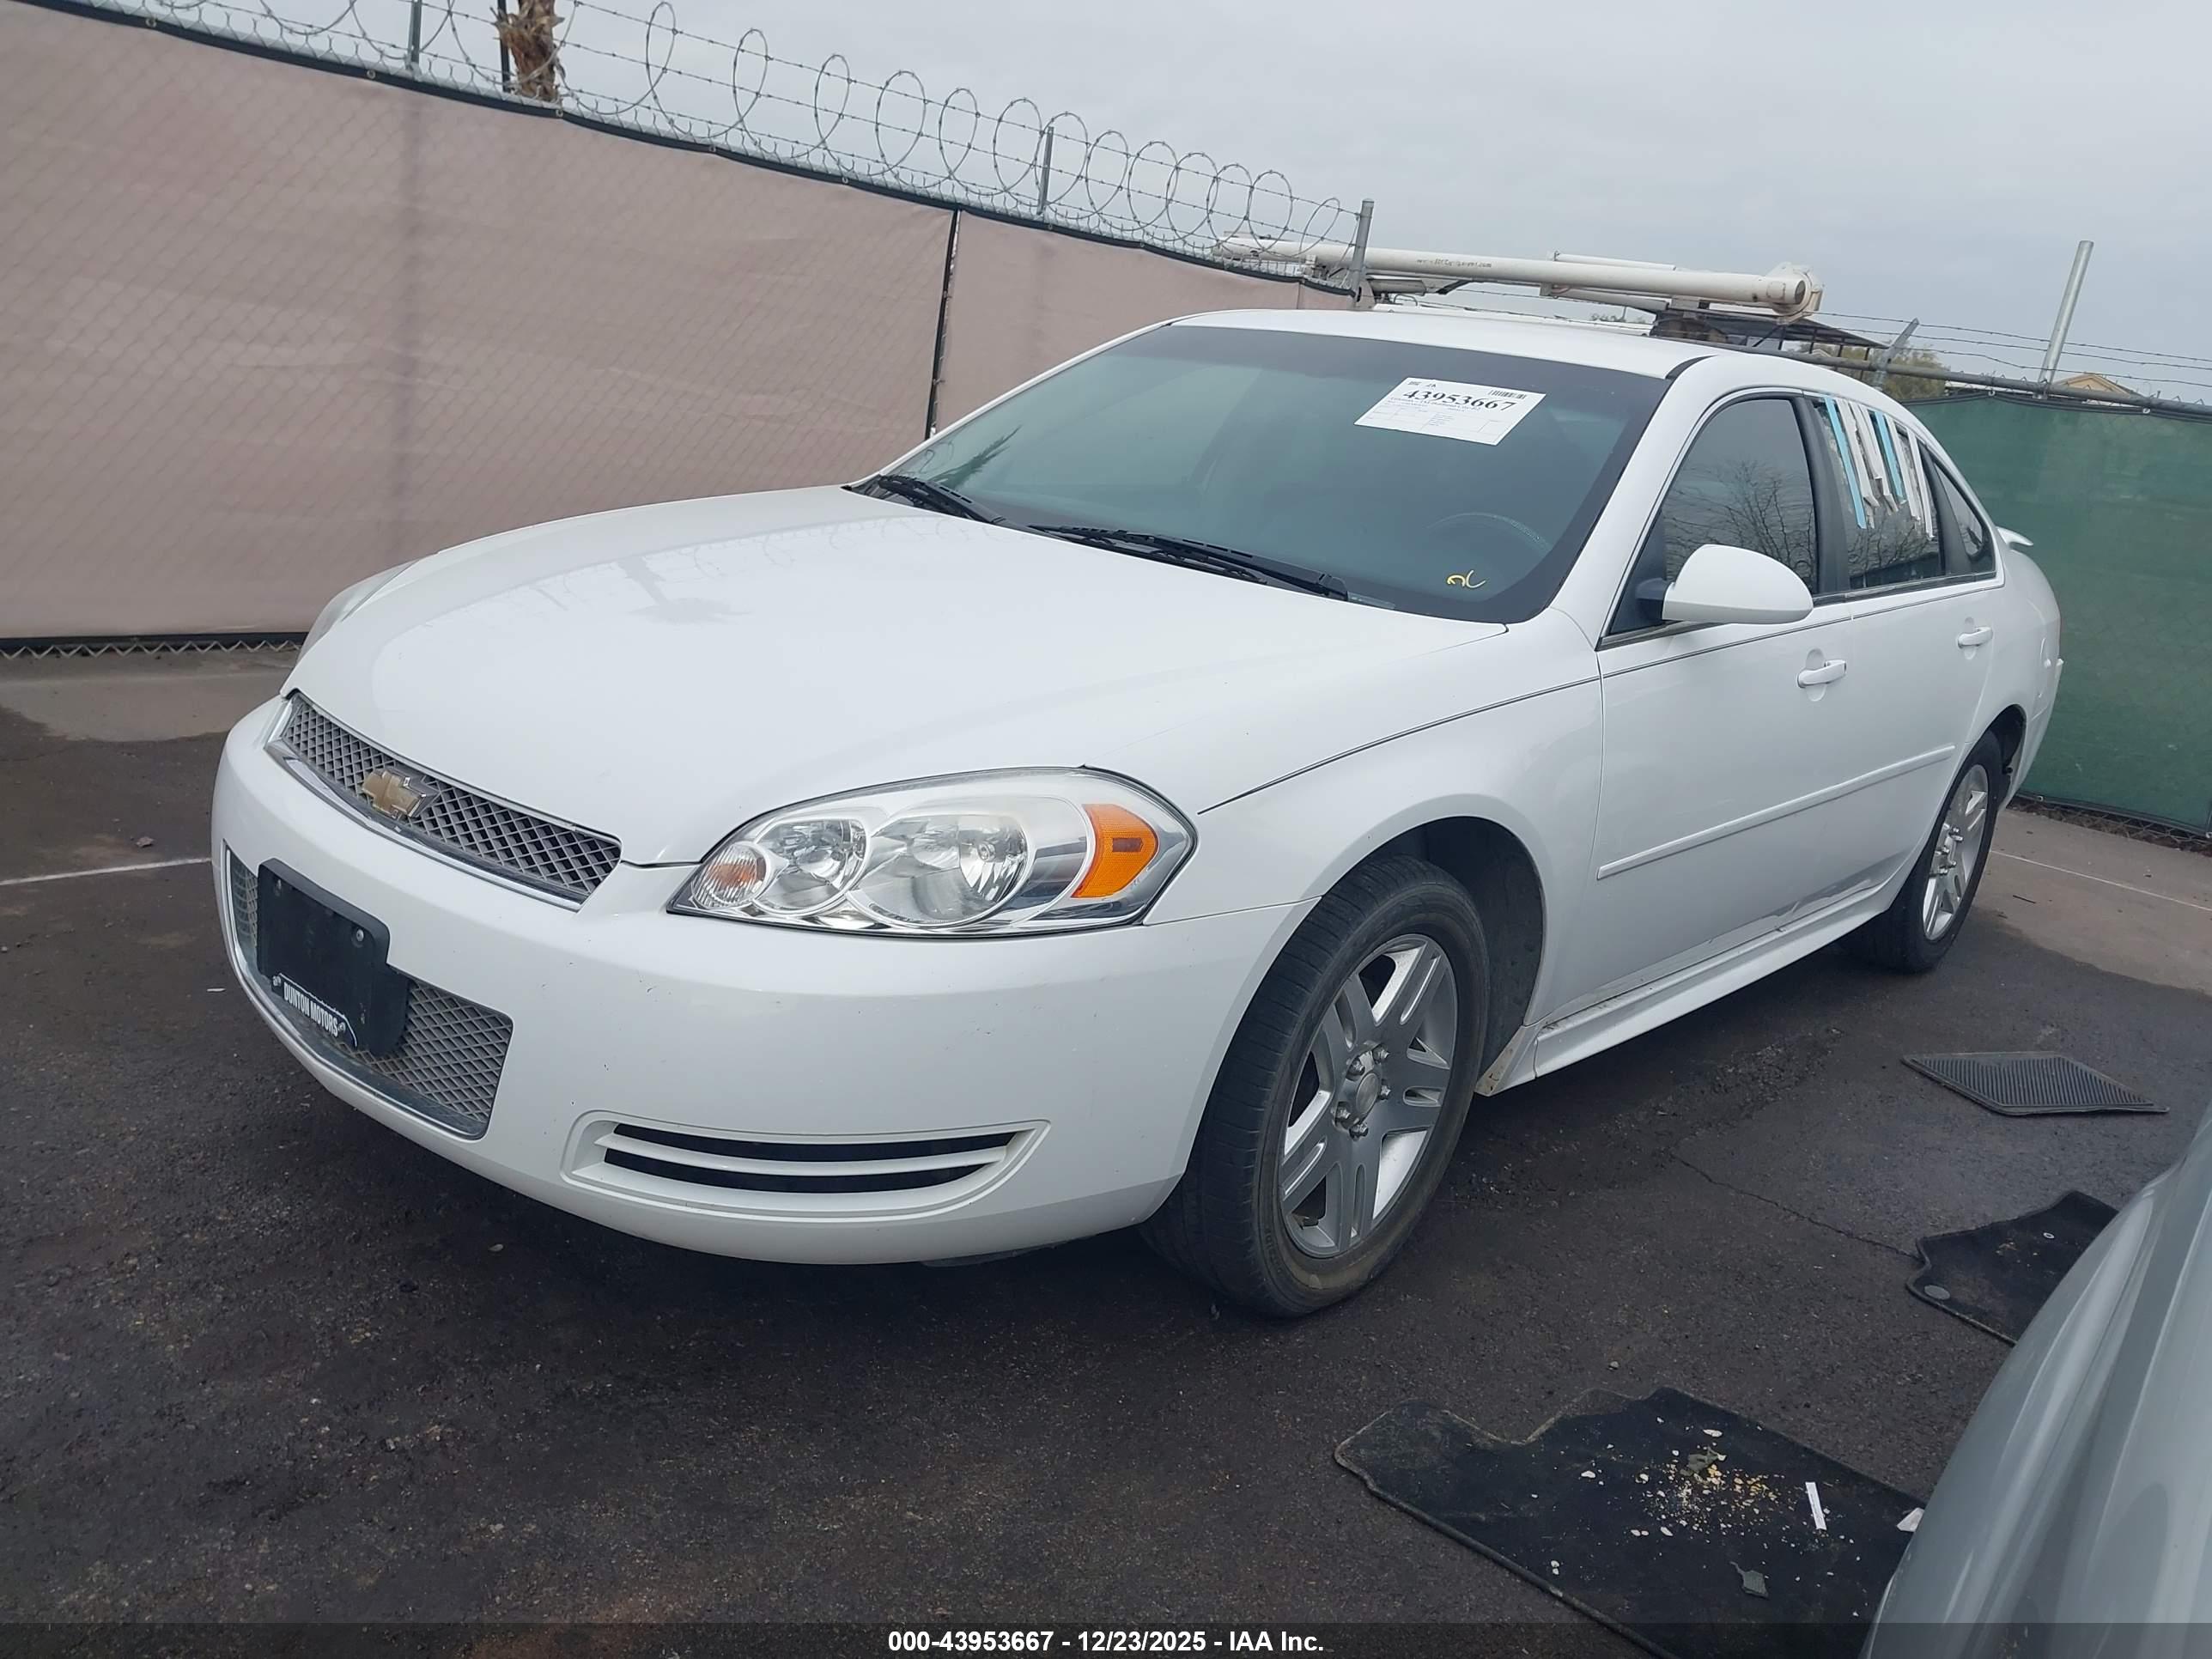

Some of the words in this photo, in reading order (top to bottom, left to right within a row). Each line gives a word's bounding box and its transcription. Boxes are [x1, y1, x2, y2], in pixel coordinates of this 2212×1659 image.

[1404, 390, 1517, 410] 43953667
[283, 981, 310, 1018] DUNTON
[310, 1000, 338, 1037] MOTORS
